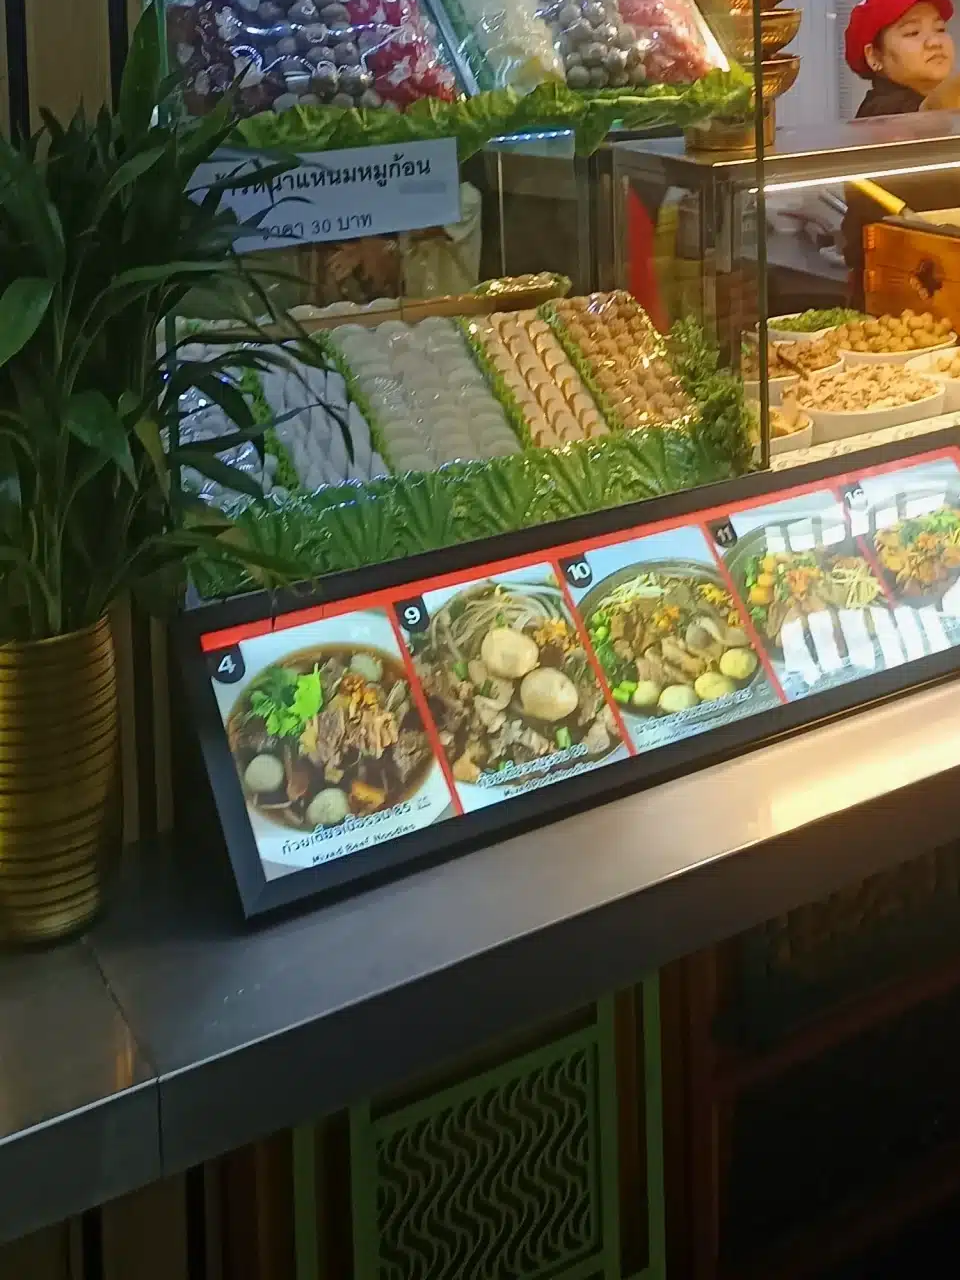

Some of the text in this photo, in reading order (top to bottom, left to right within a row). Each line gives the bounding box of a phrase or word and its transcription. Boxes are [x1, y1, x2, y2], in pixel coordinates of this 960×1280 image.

[311, 220, 331, 236] 30
[337, 213, 373, 231] บาท
[716, 525, 732, 543] 11
[568, 560, 590, 582] 10
[403, 607, 422, 626] 9
[216, 656, 238, 675] 4
